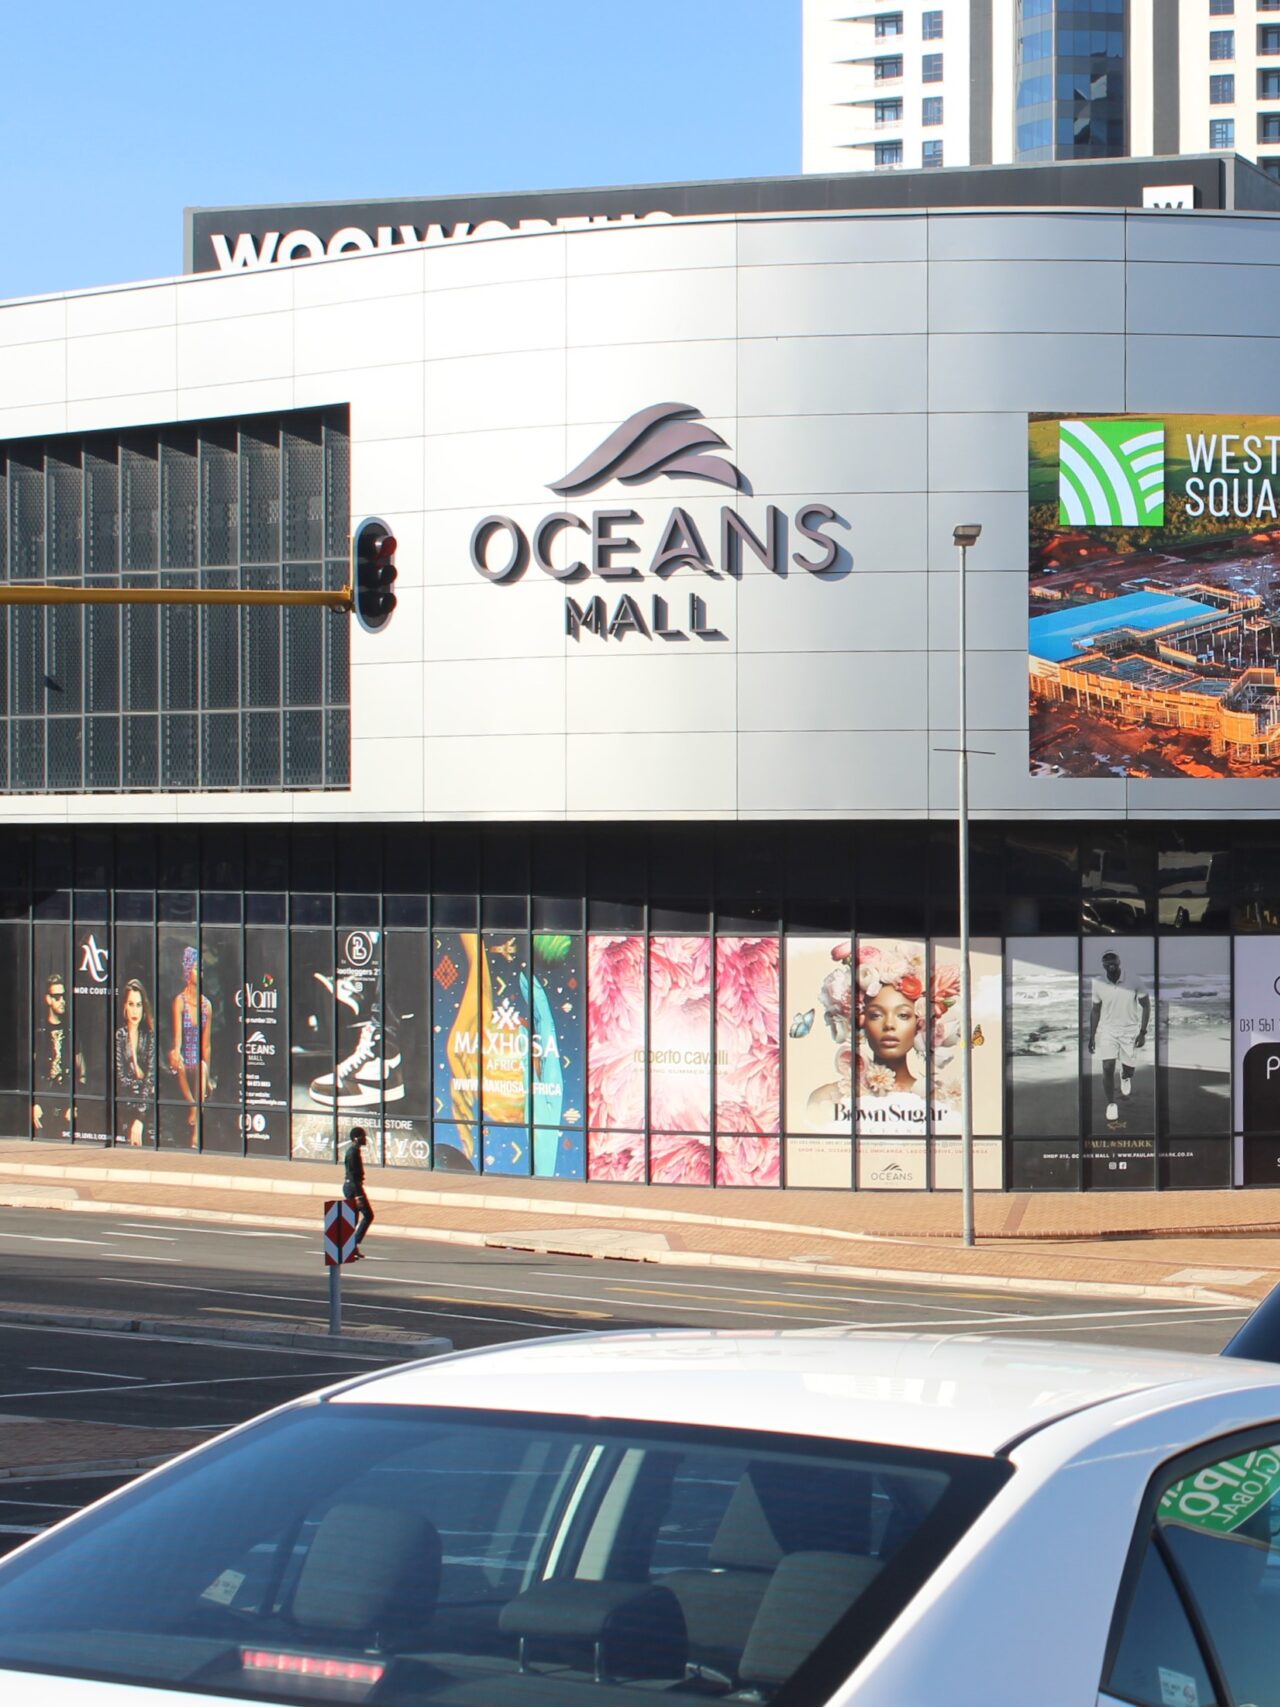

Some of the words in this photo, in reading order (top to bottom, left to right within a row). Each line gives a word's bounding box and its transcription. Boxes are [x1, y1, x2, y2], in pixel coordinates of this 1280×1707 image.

[469, 503, 842, 583] OCEANS
[565, 592, 724, 639] MALL
[1239, 1018, 1254, 1033] 031
[1258, 1018, 1275, 1032] 561
[684, 1050, 729, 1065] cavlli
[385, 1119, 414, 1130] STORE
[1117, 1140, 1153, 1148] SHARK
[871, 1172, 913, 1181] OCEANS
